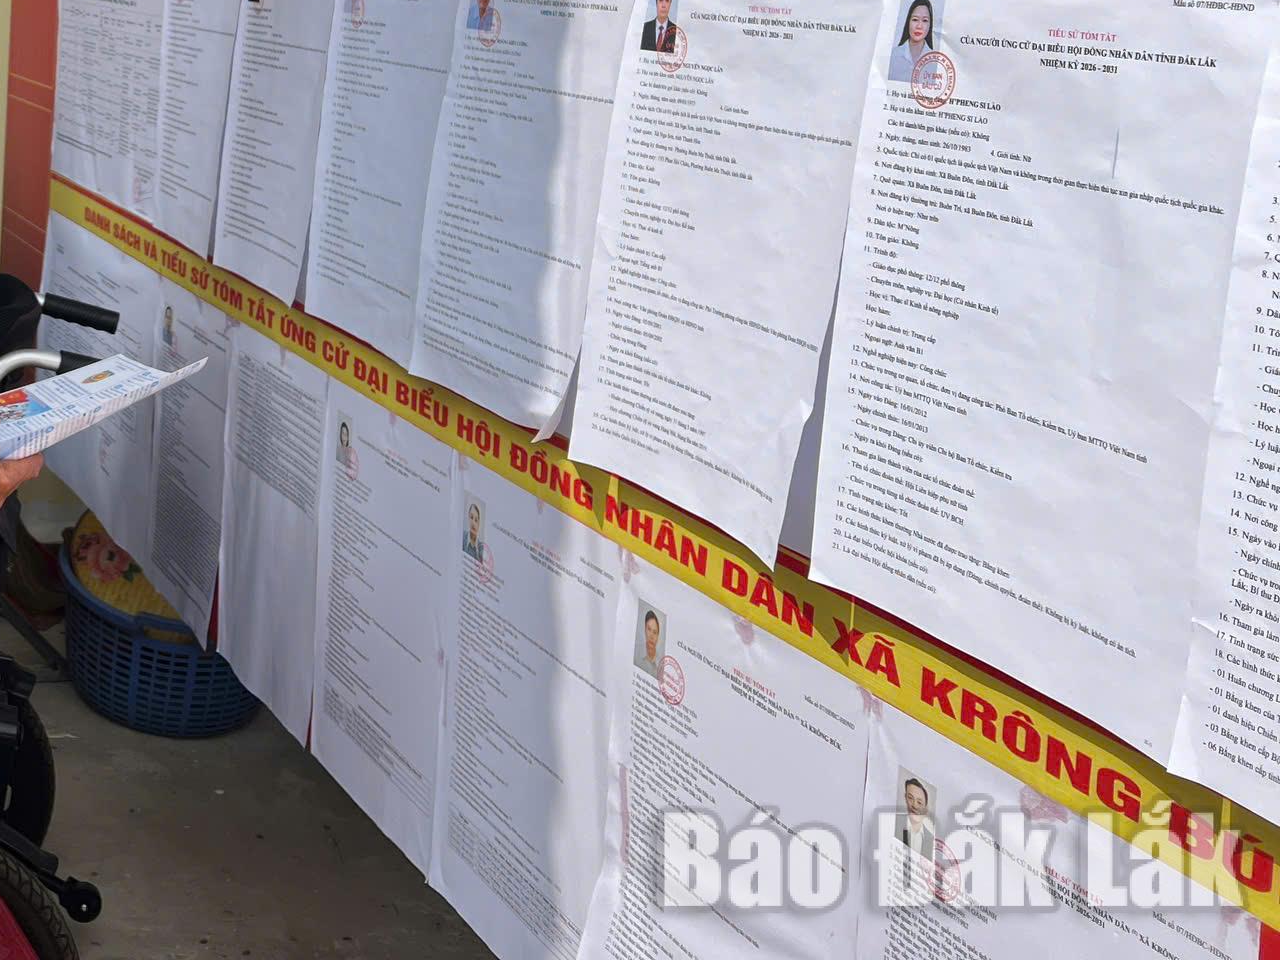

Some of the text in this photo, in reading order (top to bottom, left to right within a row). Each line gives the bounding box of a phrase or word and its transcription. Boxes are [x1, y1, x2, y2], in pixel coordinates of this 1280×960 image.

[960, 35, 975, 45] CỦA
[1032, 44, 1046, 53] ĐẠI
[1047, 42, 1065, 53] BIỂU
[1067, 46, 1082, 56] HỘI
[1109, 49, 1133, 59] NHÂN
[1135, 50, 1154, 61] DÂN
[1155, 52, 1176, 63] TỈNH
[1177, 54, 1197, 65] ĐẮK
[1198, 56, 1216, 67] LẮK
[1040, 58, 1065, 69] NHIỆM
[1080, 62, 1096, 72] 2026
[1102, 65, 1118, 74] 2031
[113, 223, 141, 250] SÁCH
[143, 240, 158, 259] VÀ
[160, 251, 187, 276] TIỂU
[191, 266, 208, 289] SỬ
[213, 281, 243, 309] TÓM
[247, 298, 273, 328] TẮT
[280, 317, 315, 352] ỨNG
[322, 341, 348, 368] CỬ
[353, 357, 388, 394] ĐẠI
[395, 381, 448, 428] BIỂU
[456, 415, 500, 458] HỘI
[510, 443, 593, 511] ĐỒNG
[603, 494, 708, 576] NHÂN
[720, 559, 814, 638] DÂN
[831, 619, 900, 688] XÃ
[919, 665, 1141, 822] KRÔNG
